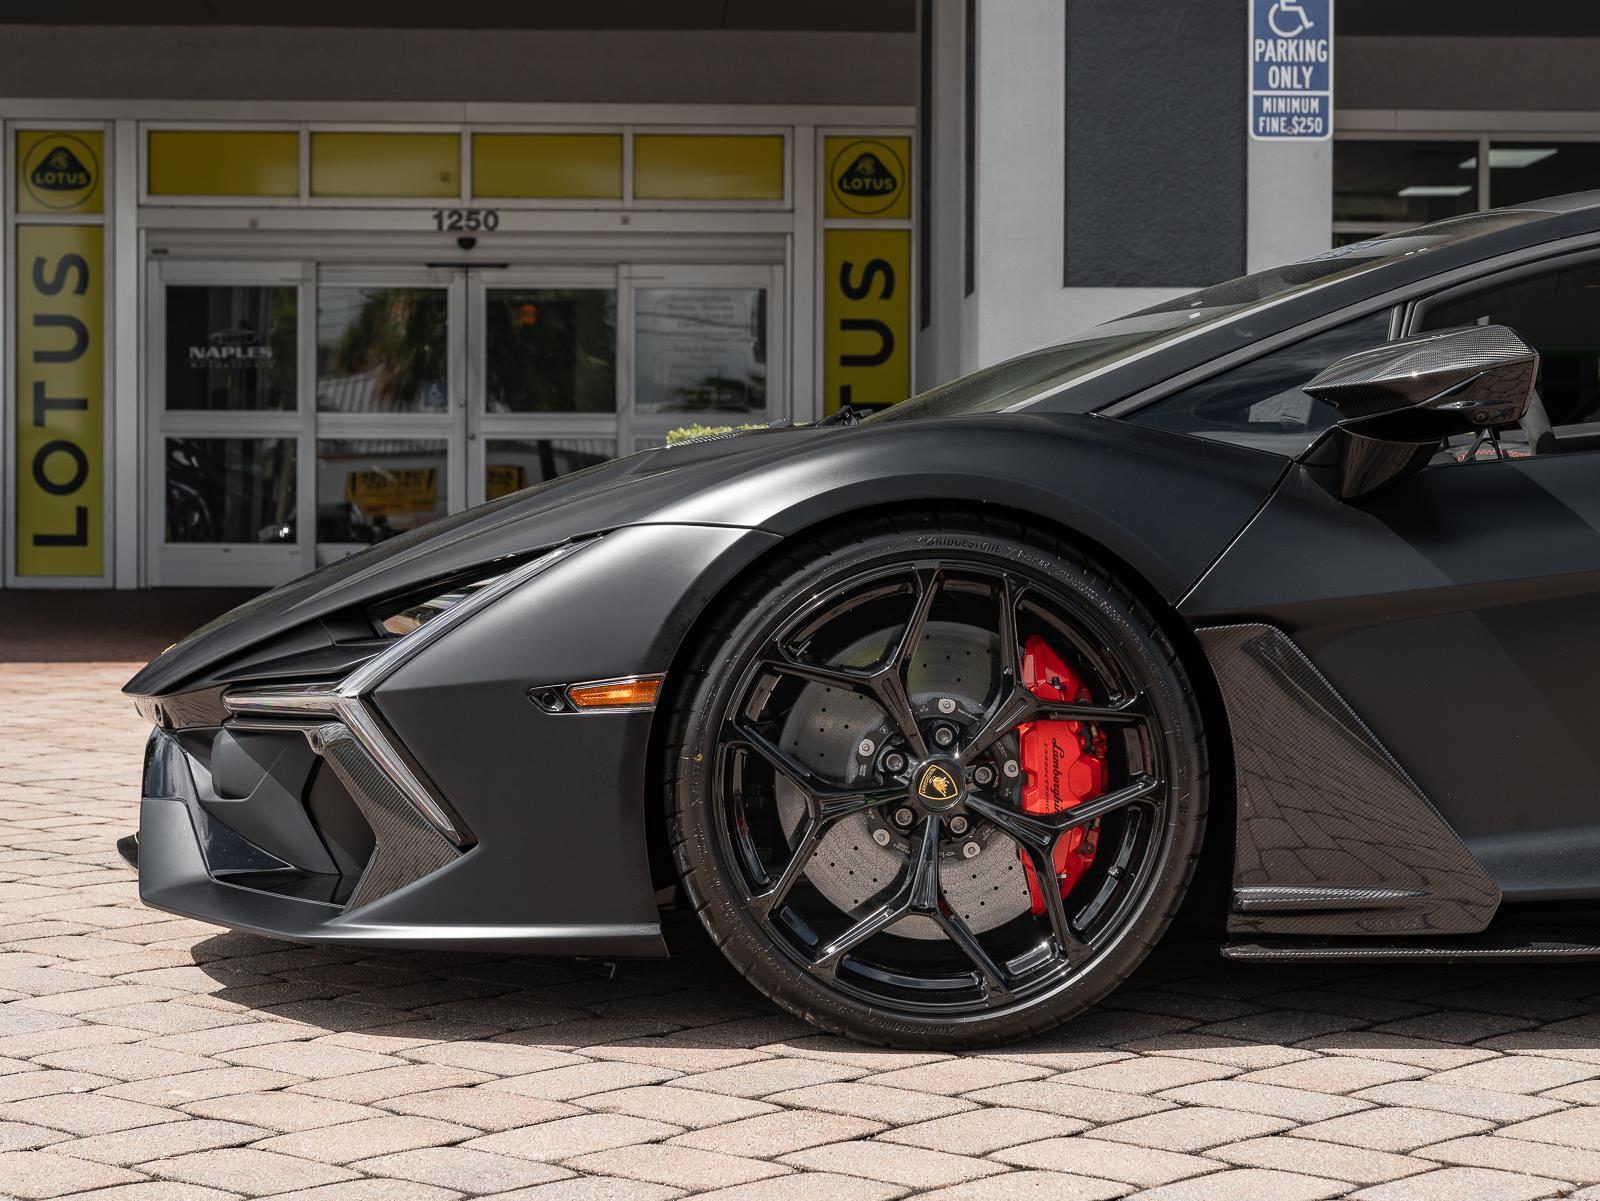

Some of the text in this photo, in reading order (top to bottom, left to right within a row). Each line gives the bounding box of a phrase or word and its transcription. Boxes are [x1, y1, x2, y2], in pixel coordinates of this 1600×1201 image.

[1254, 39, 1328, 62] PARKING
[1268, 65, 1314, 89] ONLY
[1263, 97, 1319, 114] MINIMUM
[1258, 115, 1323, 135] FINE $250
[35, 172, 87, 185] LOTUS
[842, 177, 893, 190] LOTUS
[432, 208, 499, 232] 1250
[188, 346, 273, 359] NAPLES
[32, 253, 90, 547] LOTUS
[926, 536, 1001, 552] BRIDGESTONE
